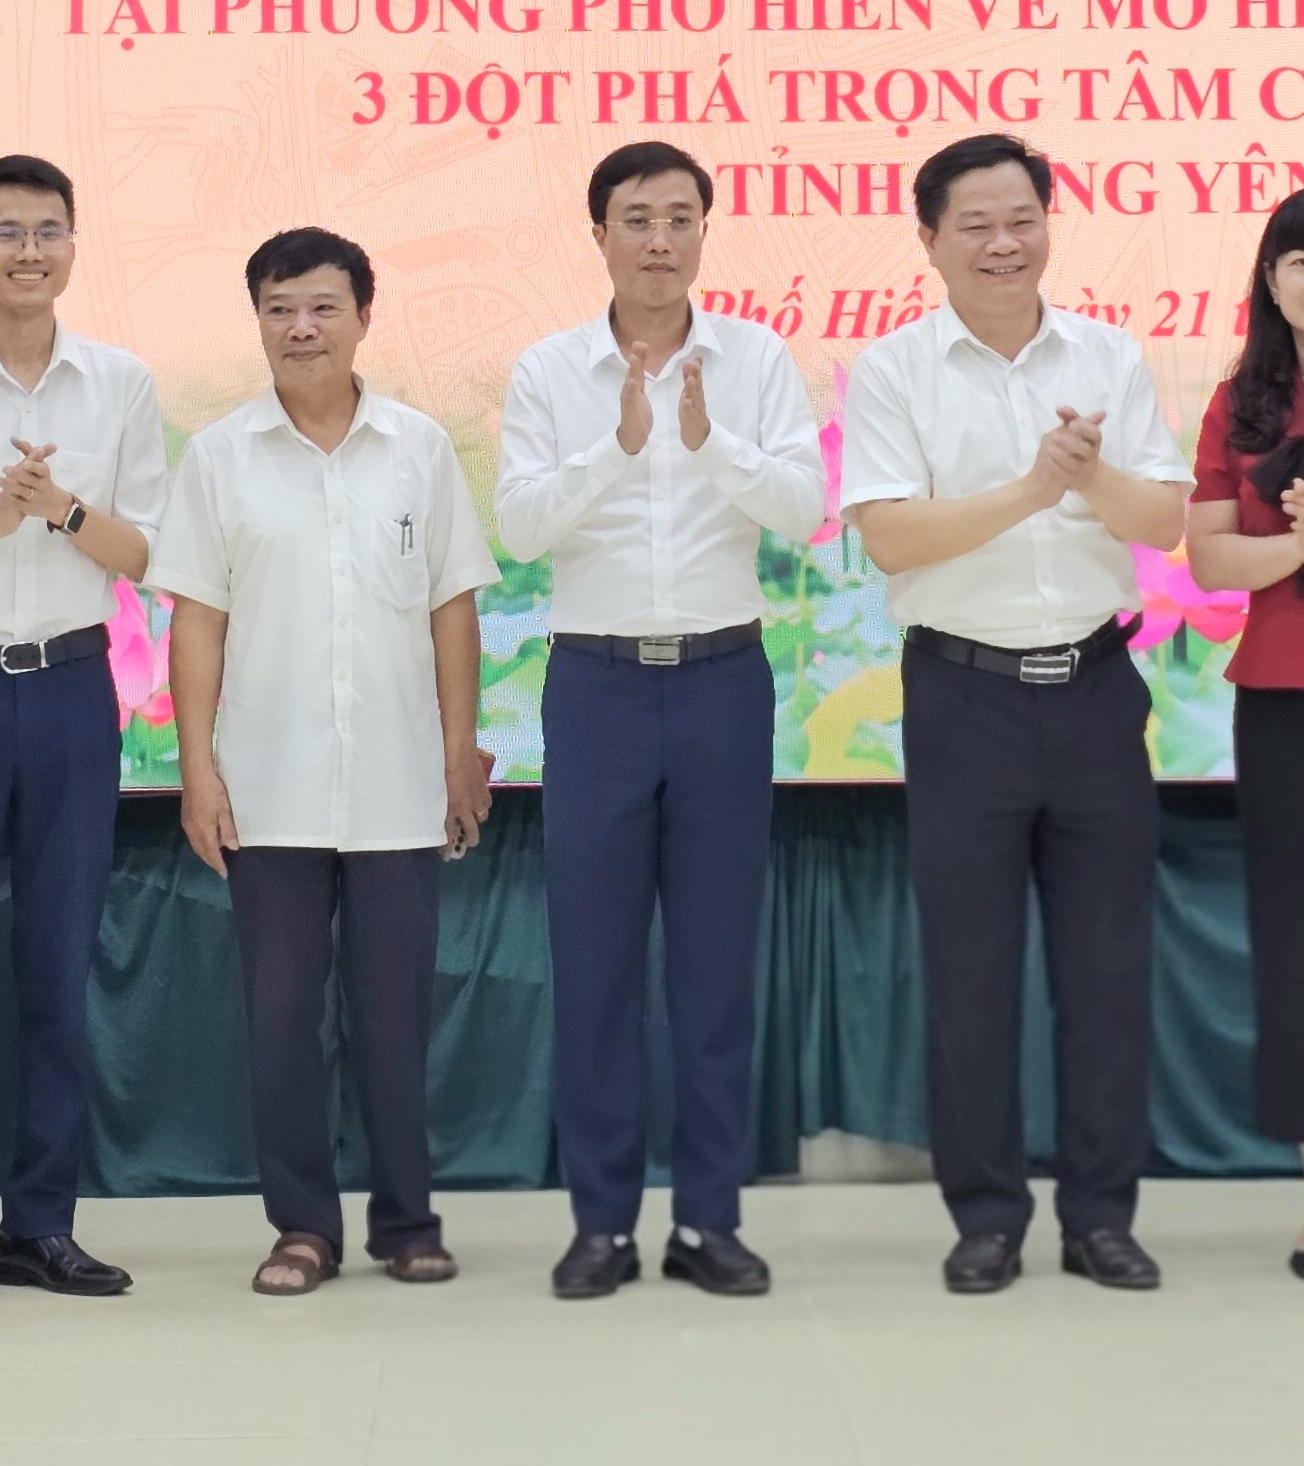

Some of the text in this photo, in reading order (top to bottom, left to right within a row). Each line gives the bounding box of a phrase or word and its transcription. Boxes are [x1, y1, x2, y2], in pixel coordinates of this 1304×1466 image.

[351, 71, 388, 126] 3
[409, 62, 574, 141] ĐỘT
[595, 53, 750, 125] PHÁ
[767, 67, 1044, 139] TRỌNG
[1061, 50, 1235, 121] TÂM
[714, 145, 906, 217] TỈNH
[1042, 153, 1160, 215] NG
[820, 275, 940, 338] Hiế
[1148, 290, 1212, 338] 21
